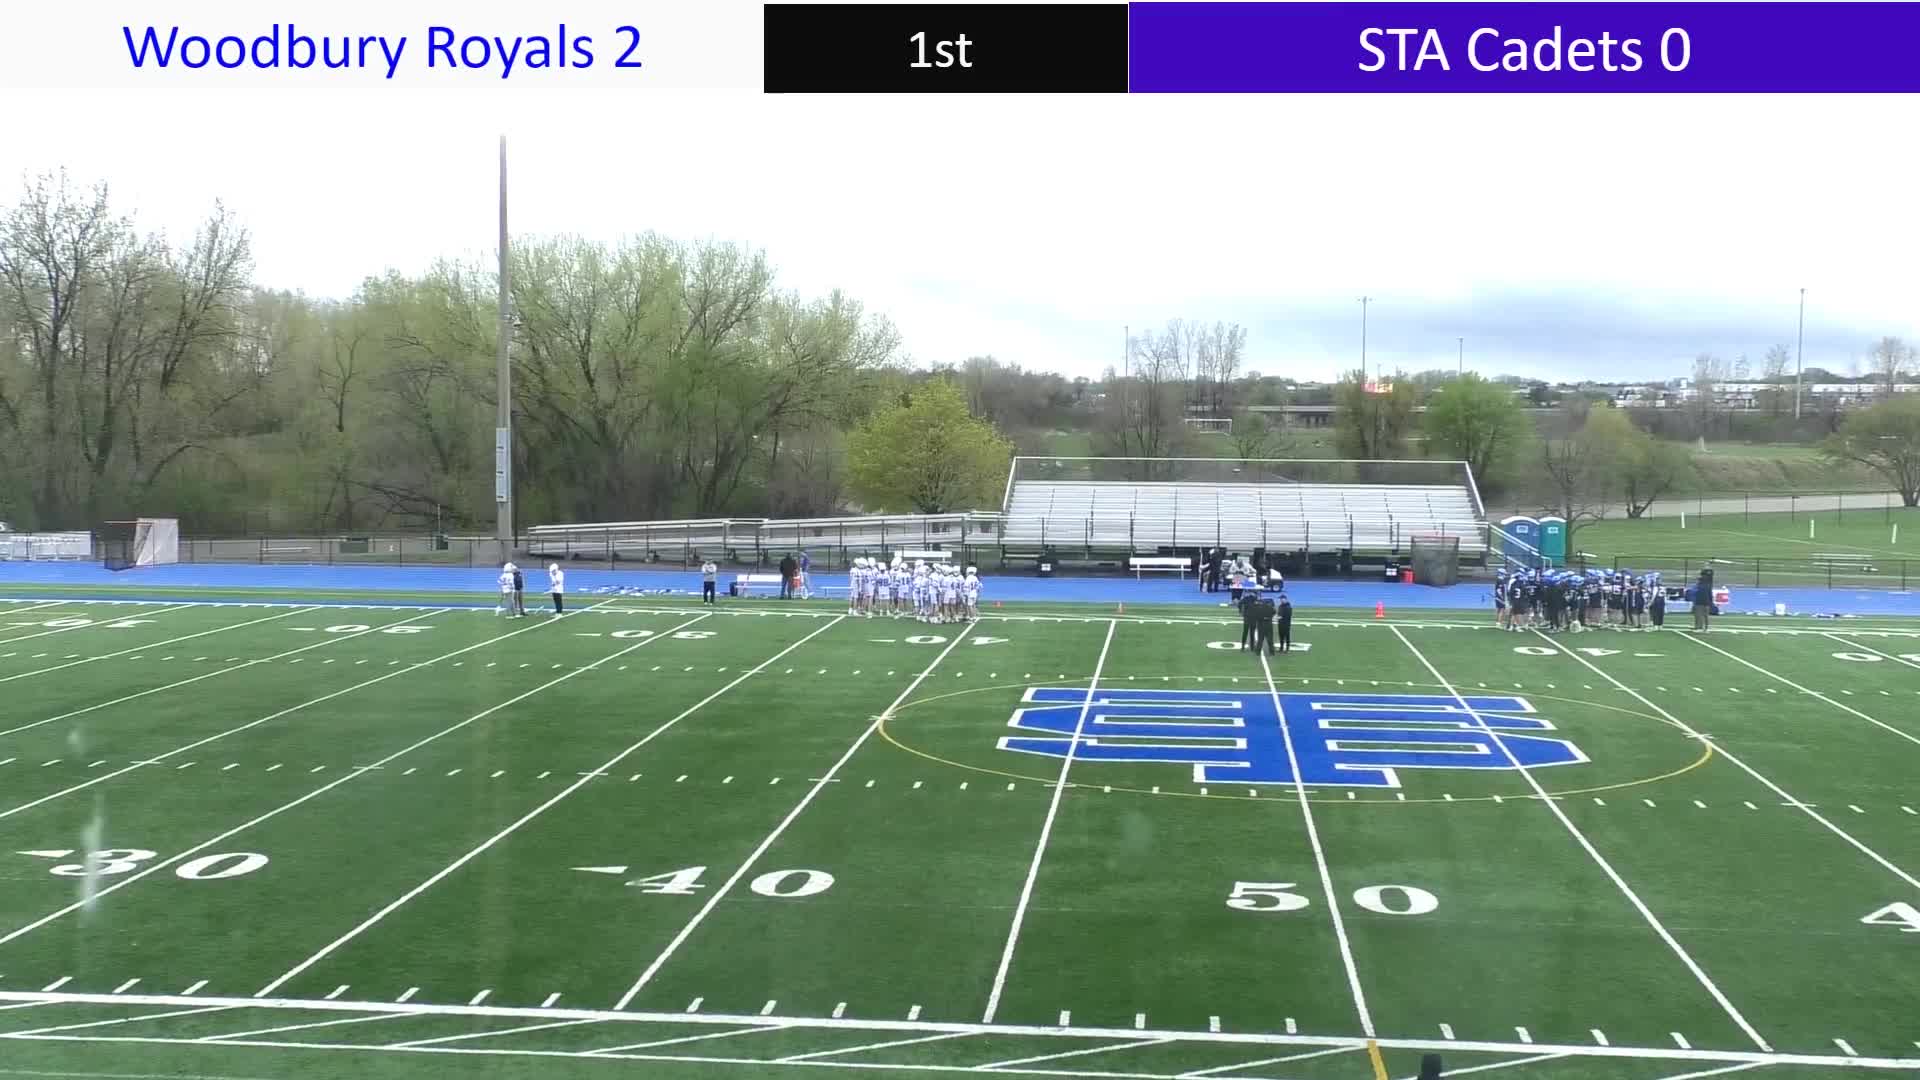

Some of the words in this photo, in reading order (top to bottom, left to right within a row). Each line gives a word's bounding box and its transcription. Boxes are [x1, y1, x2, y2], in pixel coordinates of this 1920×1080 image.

[48, 848, 269, 880] 30
[625, 865, 835, 898] 40
[1226, 881, 1440, 915] 50
